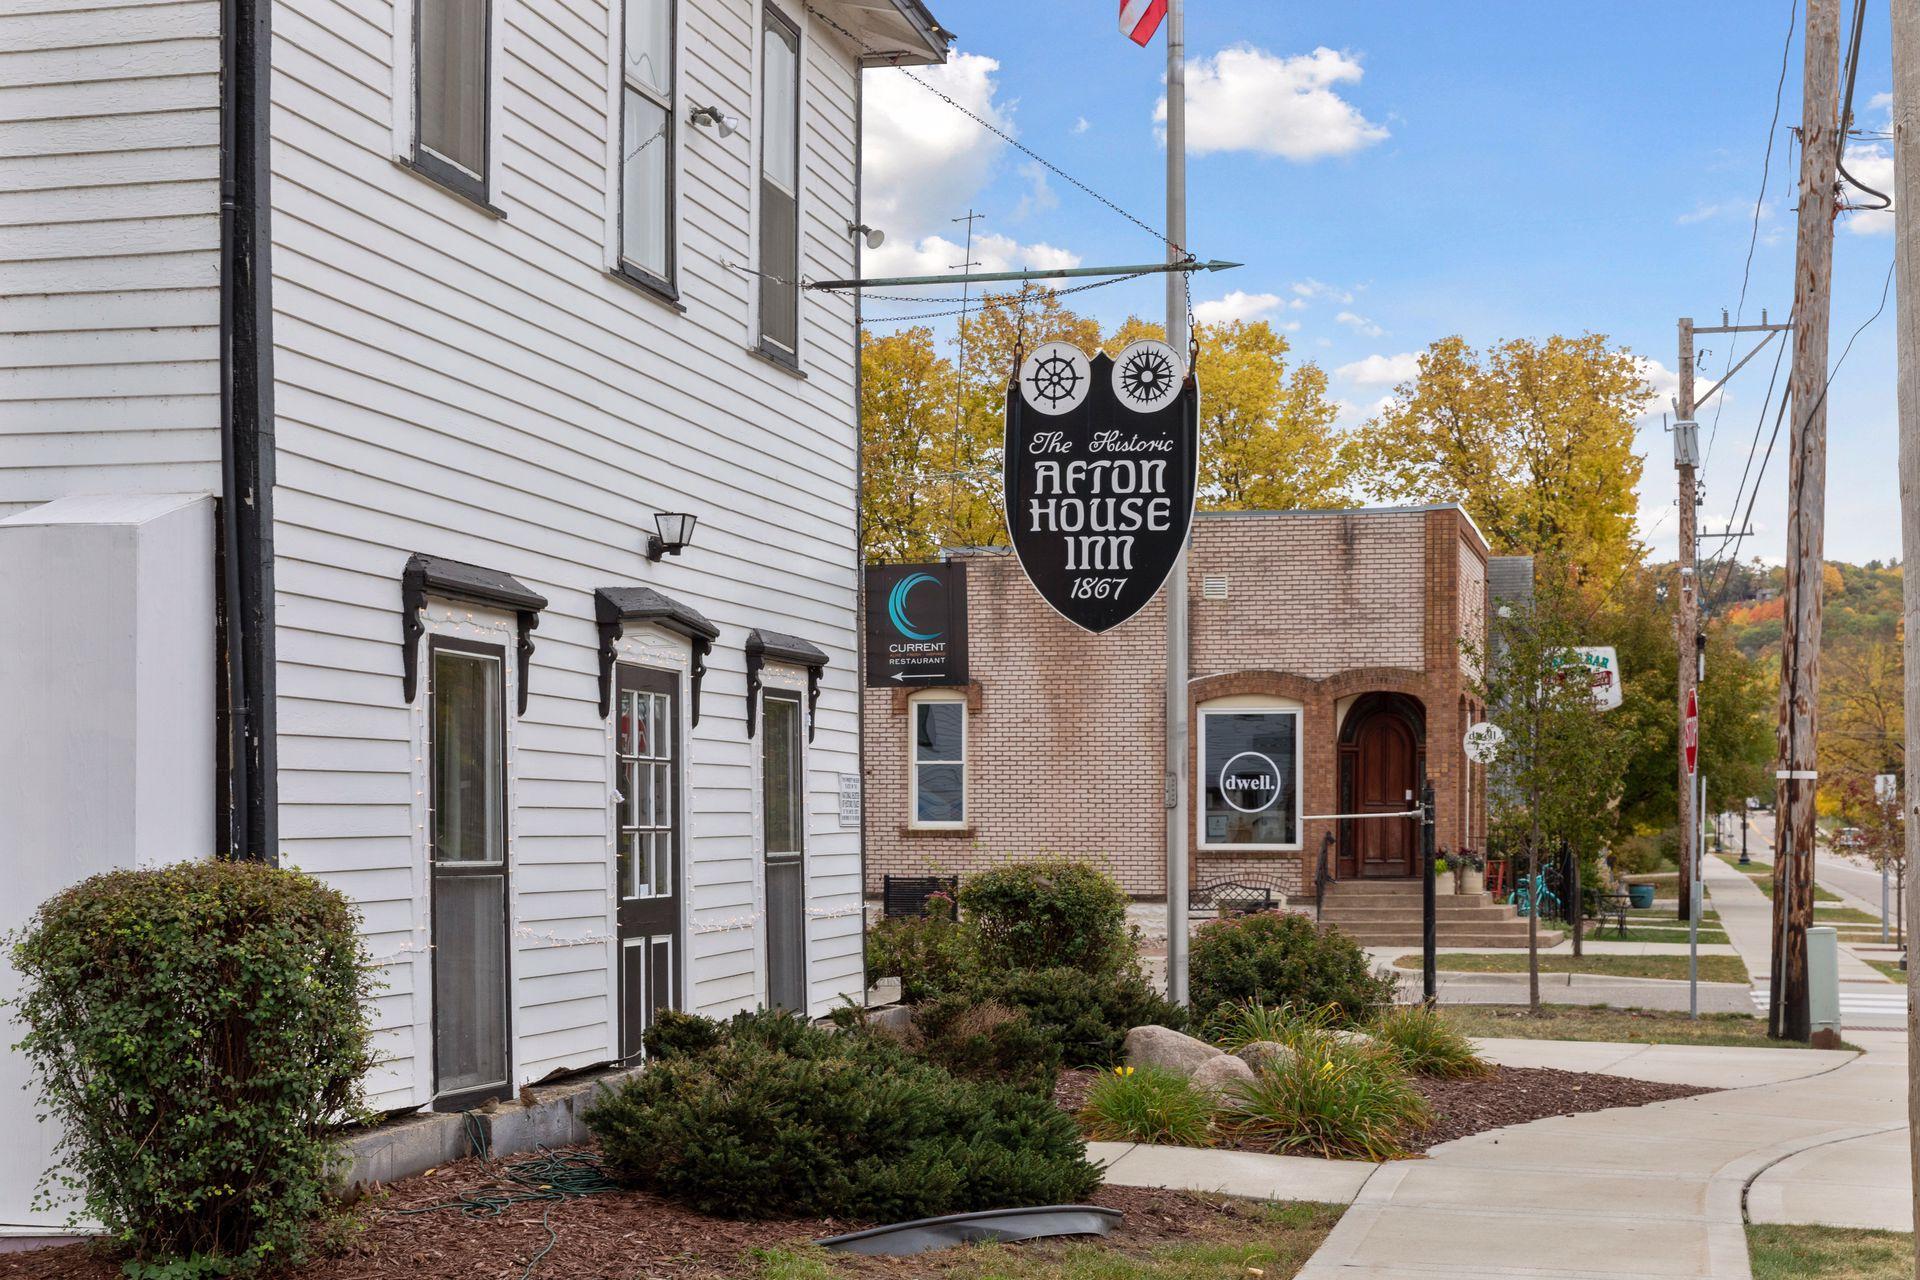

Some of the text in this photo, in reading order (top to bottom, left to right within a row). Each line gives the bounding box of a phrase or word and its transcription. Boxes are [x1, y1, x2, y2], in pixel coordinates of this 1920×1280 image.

[1028, 429, 1175, 455] The Historic
[1034, 460, 1167, 495] AFTON
[1029, 497, 1171, 532] HOUSE
[1063, 535, 1135, 570] INN
[1070, 577, 1129, 600] 1867
[889, 643, 946, 653] CURRENT
[889, 657, 946, 665] RESTAURANT
[1225, 775, 1276, 790] dwell.
